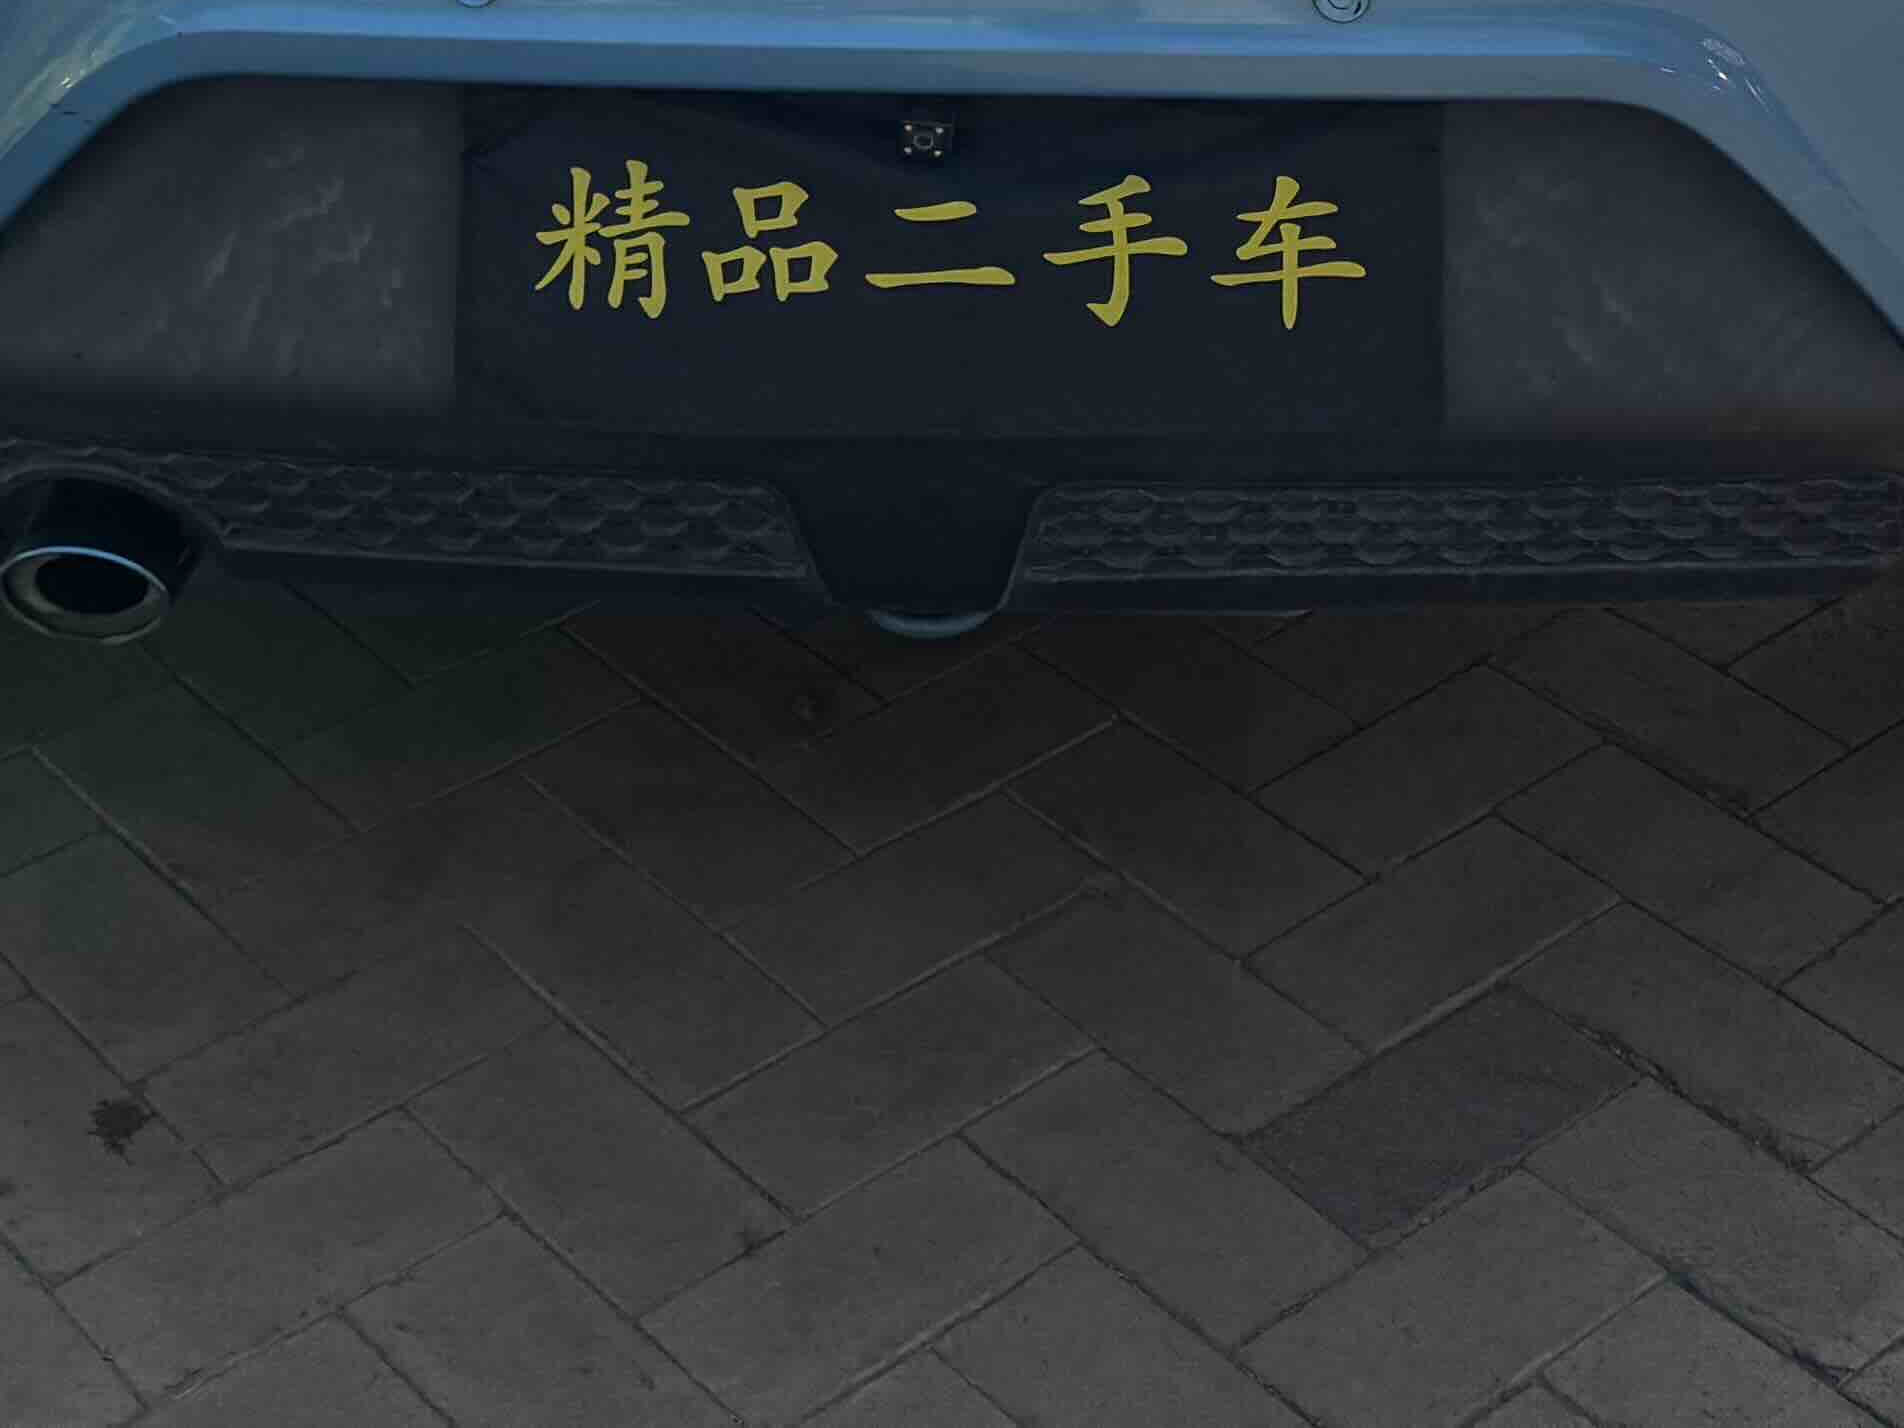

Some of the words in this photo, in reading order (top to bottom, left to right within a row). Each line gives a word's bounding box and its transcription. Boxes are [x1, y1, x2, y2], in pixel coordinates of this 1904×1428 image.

[533, 158, 1367, 330] 精品二手车
